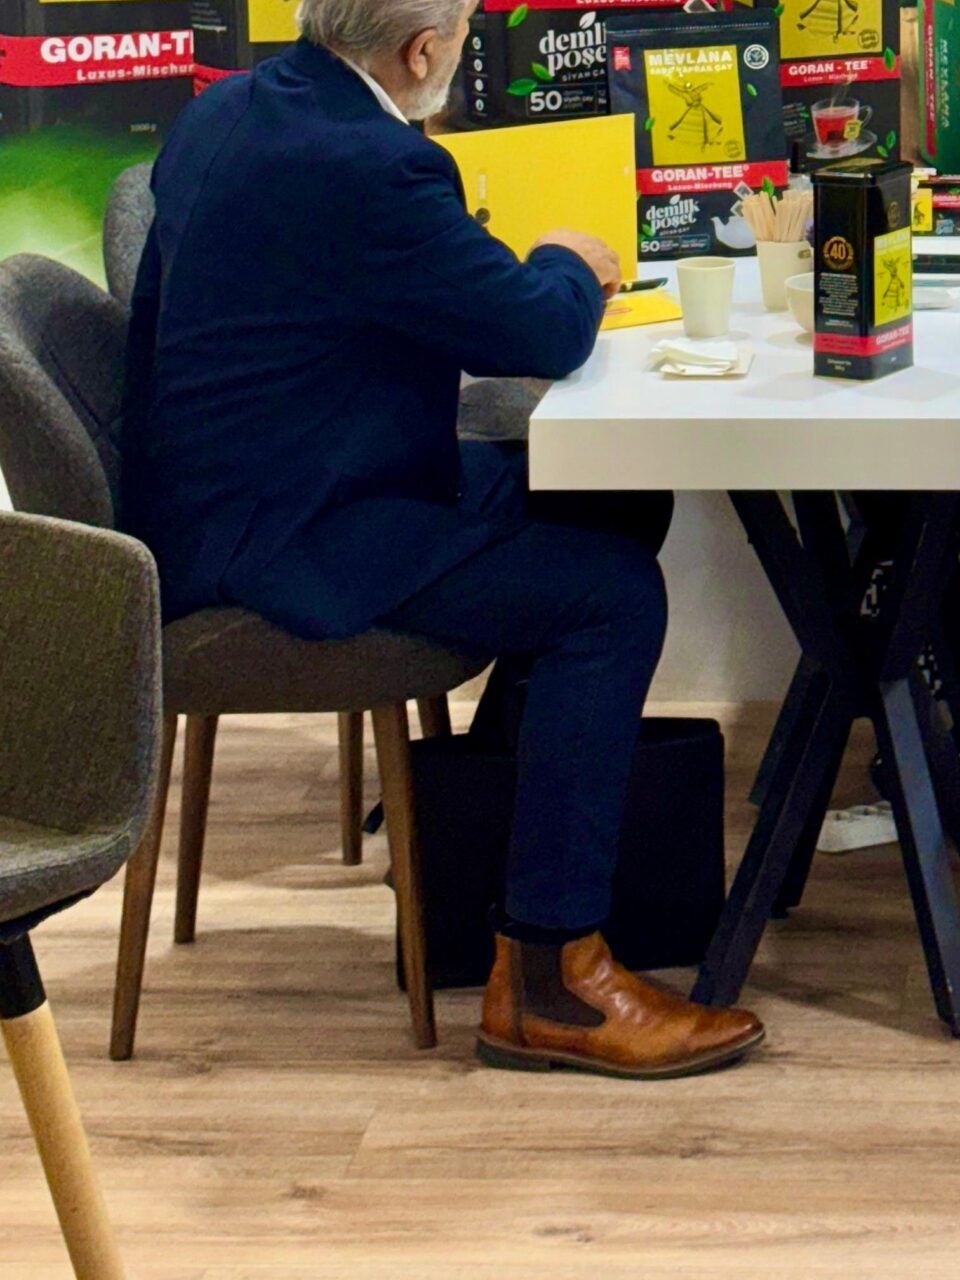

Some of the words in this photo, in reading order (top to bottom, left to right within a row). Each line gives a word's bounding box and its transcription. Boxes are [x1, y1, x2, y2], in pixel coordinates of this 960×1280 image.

[40, 29, 194, 64] GORAN-T
[539, 22, 607, 55] demli
[547, 45, 607, 77] poşe
[788, 63, 835, 76] GORAN
[845, 60, 869, 71] TEE
[593, 69, 605, 79] ÇA
[530, 91, 562, 111] 50
[646, 198, 700, 221] demlik
[640, 240, 660, 253] 50
[830, 241, 846, 259] 40
